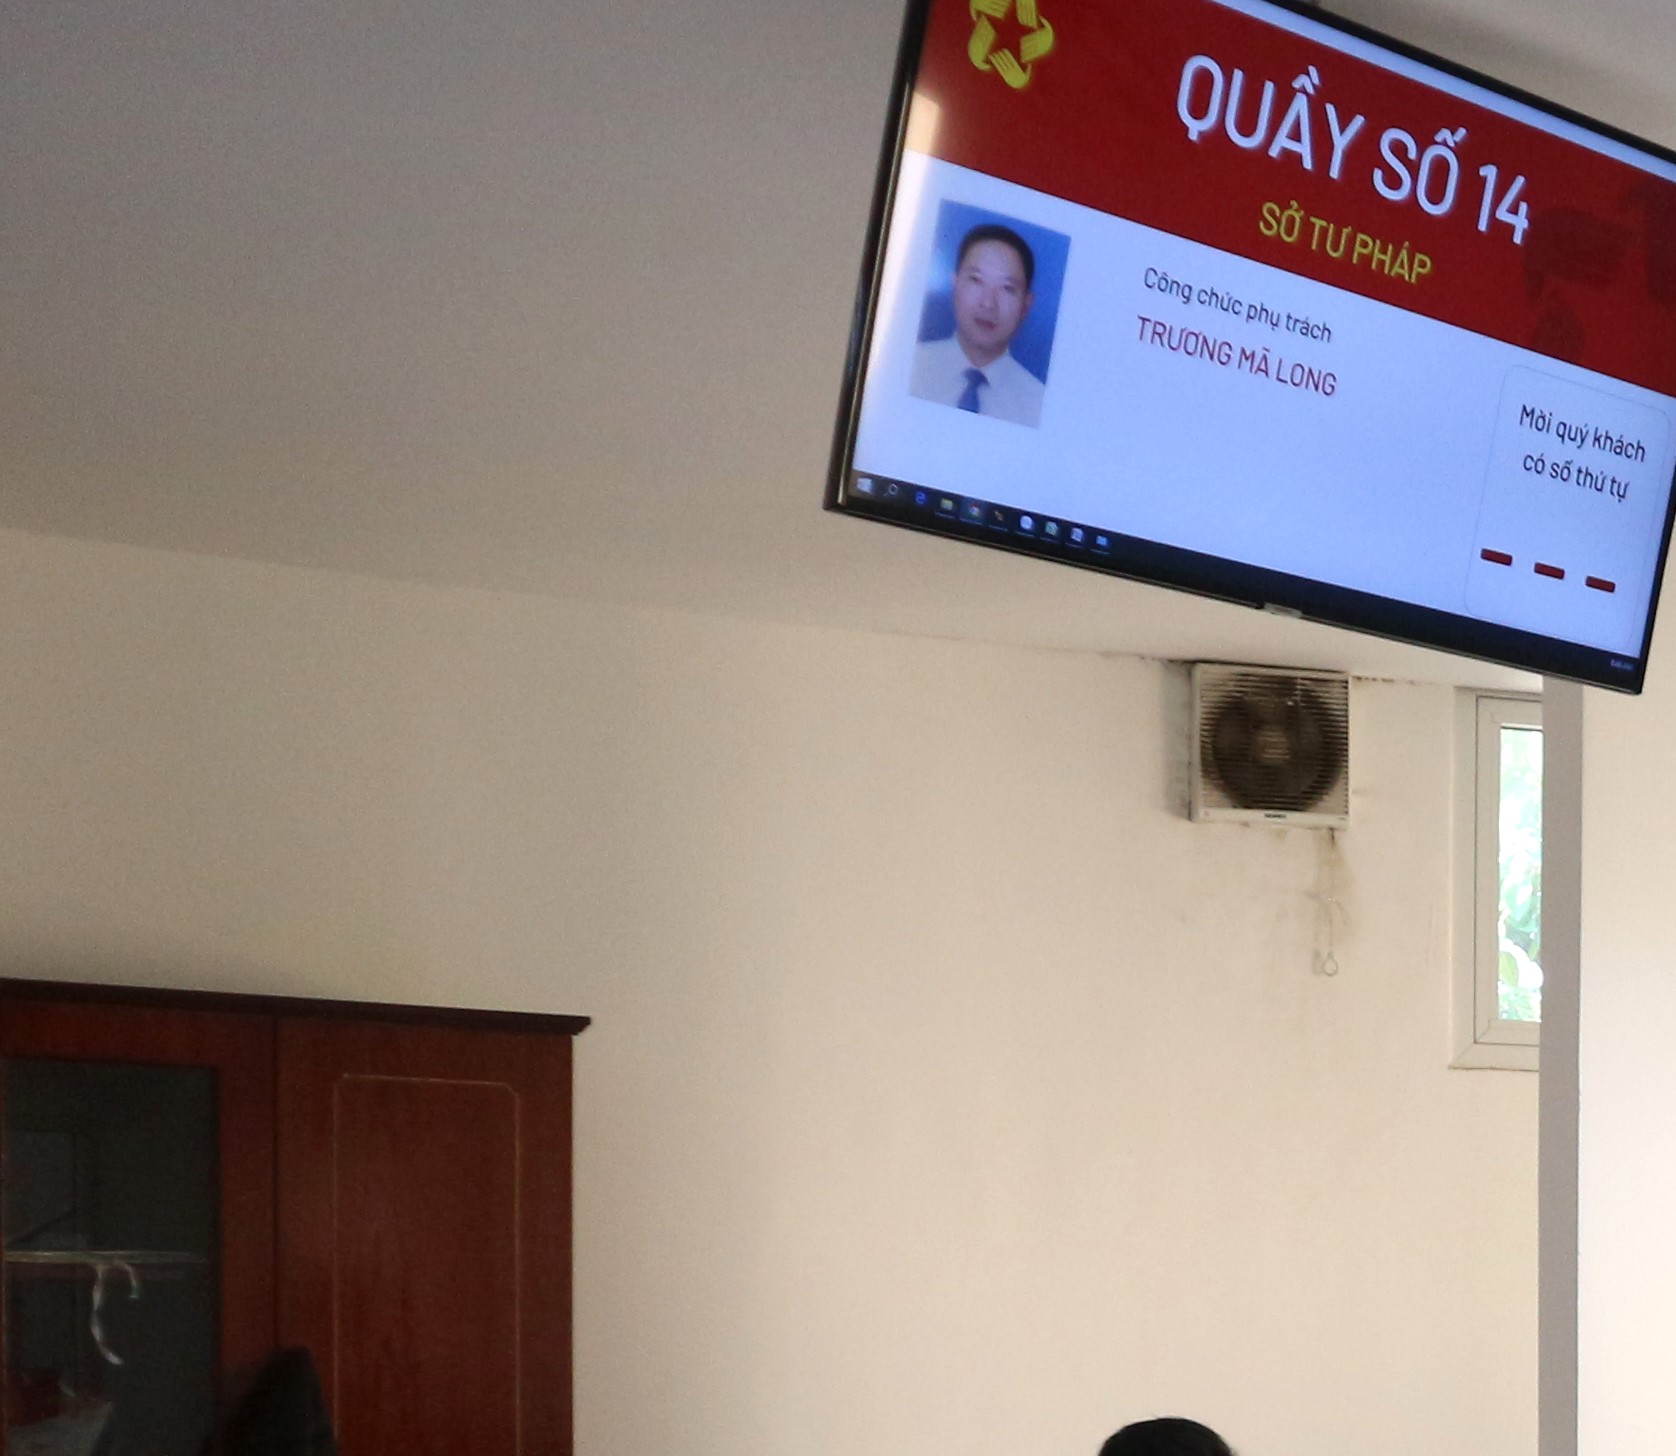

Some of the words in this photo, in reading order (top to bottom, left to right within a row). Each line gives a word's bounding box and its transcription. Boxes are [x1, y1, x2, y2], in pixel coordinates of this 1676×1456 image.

[1176, 55, 1366, 180] QUẦY
[1371, 126, 1468, 215] SỐ
[1477, 163, 1531, 246] 14
[1258, 200, 1304, 245] SỞ
[1308, 216, 1350, 259] TƯ
[1352, 233, 1432, 284] PHÁP
[1143, 266, 1193, 305] Công
[1196, 285, 1243, 317] chức
[1245, 302, 1281, 332] phụ
[1285, 311, 1332, 344] trách
[1236, 346, 1270, 379] MÃ
[1274, 357, 1338, 397] LONG
[1519, 403, 1552, 434] Mời
[1555, 419, 1590, 450] quý
[1592, 426, 1646, 463] khách
[1522, 452, 1546, 476] có
[1549, 460, 1574, 484] số
[1575, 465, 1608, 493] thứ
[1609, 476, 1631, 502] tự
